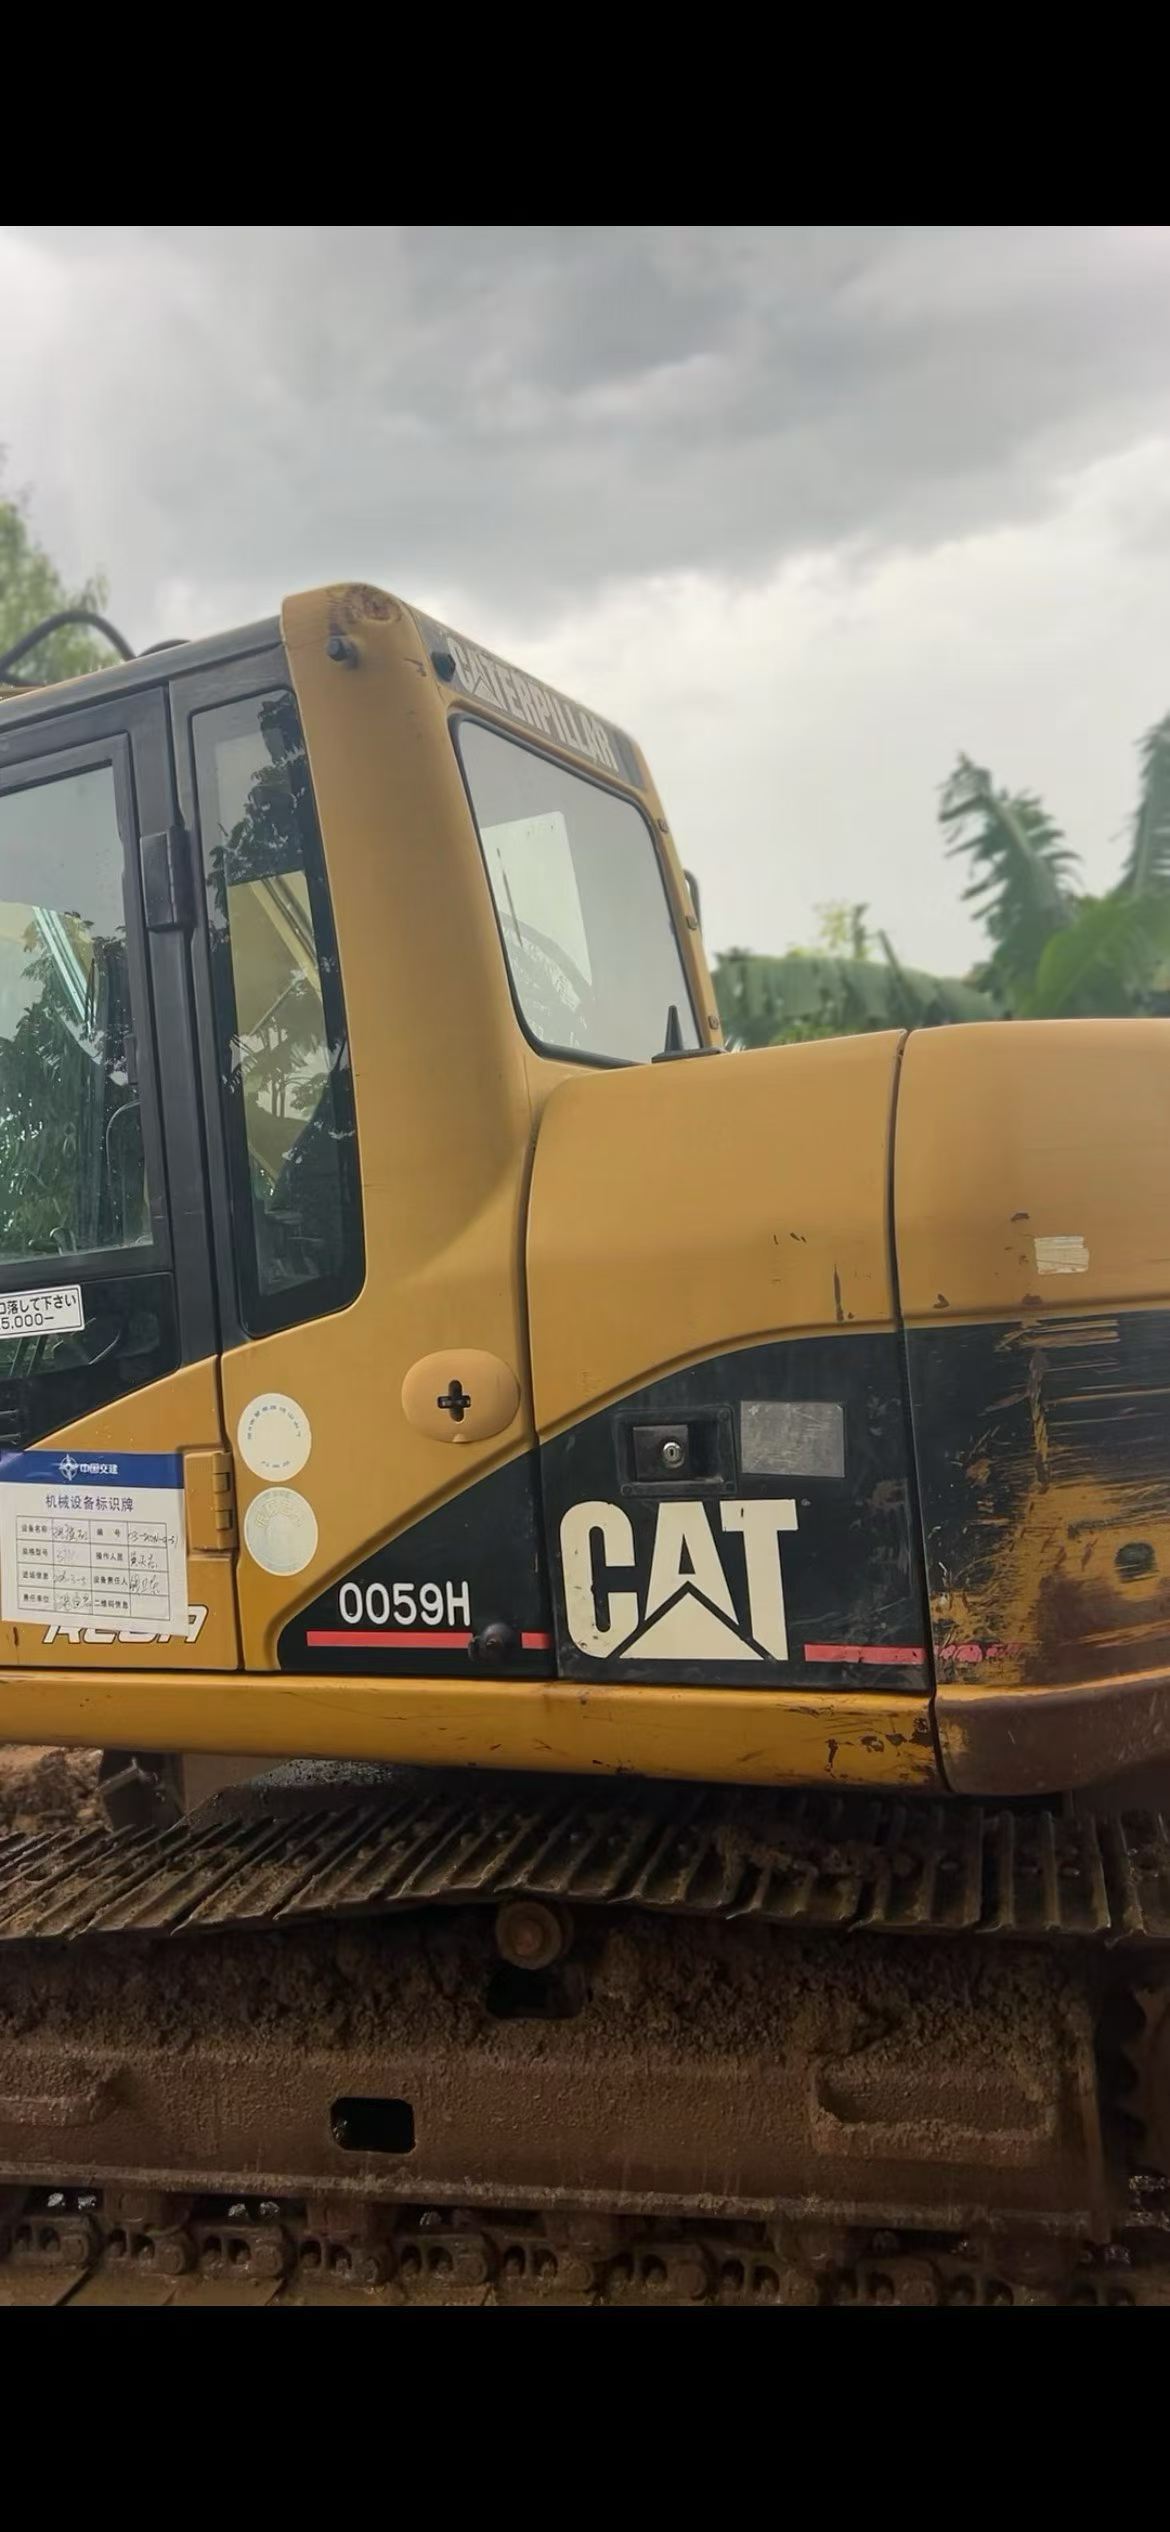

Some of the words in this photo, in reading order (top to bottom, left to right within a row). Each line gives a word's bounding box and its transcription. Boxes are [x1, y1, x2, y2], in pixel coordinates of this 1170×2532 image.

[447, 636, 620, 773] CATERPILLAR
[0, 1313, 54, 1330] 5,000-
[79, 1463, 119, 1475] 中国交建
[46, 1495, 134, 1512] 机械设备标识牌
[559, 1499, 800, 1661] CAT
[339, 1581, 471, 1627] 0059H
